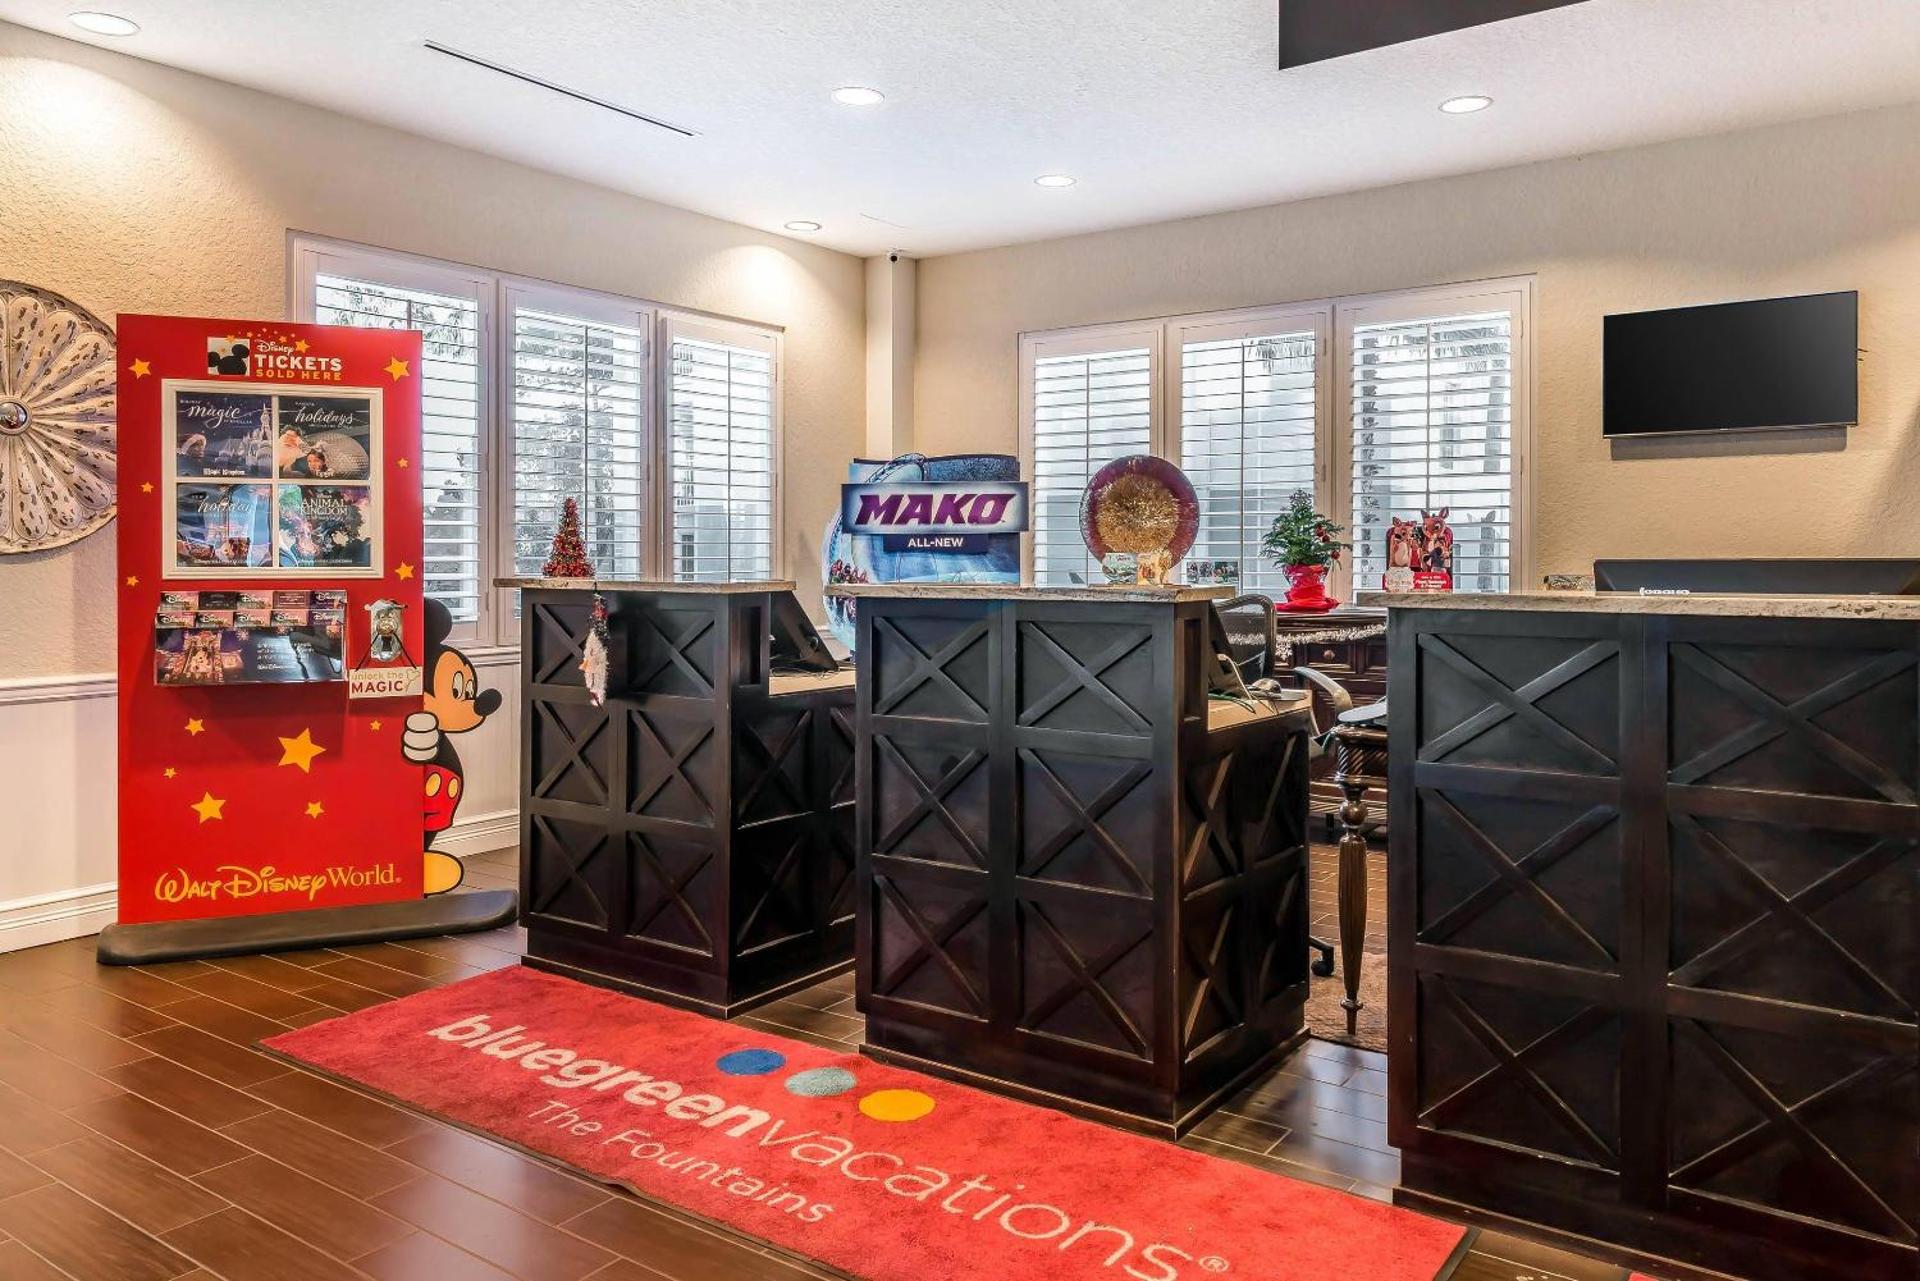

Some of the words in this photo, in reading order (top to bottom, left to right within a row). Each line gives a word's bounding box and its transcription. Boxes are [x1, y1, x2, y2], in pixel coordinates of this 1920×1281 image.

[255, 339, 294, 356] Disney
[254, 354, 343, 371] TICKETS
[255, 369, 295, 378] SOLD
[301, 371, 342, 381] HERE
[295, 406, 354, 425] holidays
[301, 498, 347, 508] ANIMAL
[854, 493, 1016, 526] MAKO
[907, 538, 964, 548] ALL-NEW
[351, 680, 403, 694] MAGIC
[216, 865, 327, 902] Disney
[527, 1099, 604, 1137] The
[601, 1125, 838, 1224] Fountains
